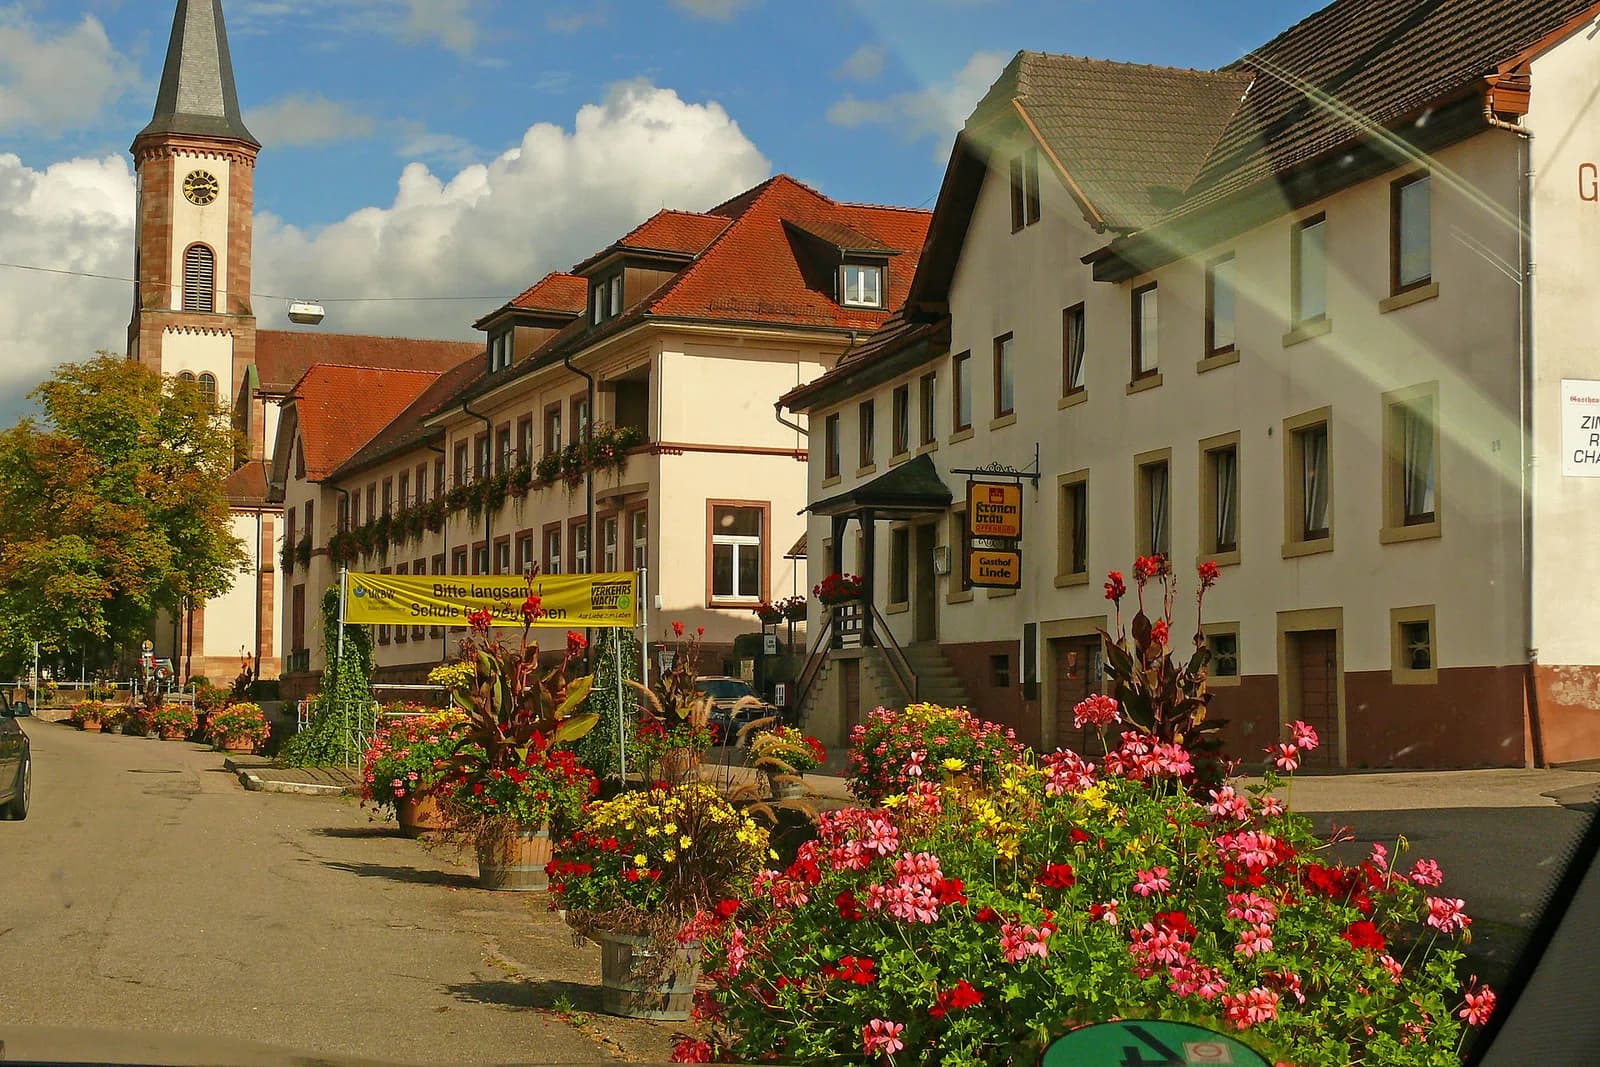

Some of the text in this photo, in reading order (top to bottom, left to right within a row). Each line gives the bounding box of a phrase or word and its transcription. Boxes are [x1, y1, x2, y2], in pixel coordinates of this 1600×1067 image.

[1579, 163, 1598, 202] G
[1589, 433, 1600, 446] R
[980, 557, 1011, 567] Gasthof
[980, 567, 1011, 578] Linde
[433, 583, 466, 598] Bitte
[591, 584, 632, 596] VERKEHRS
[591, 595, 619, 606] WACHT
[410, 602, 459, 617] Schule
[492, 605, 567, 621] begnen
